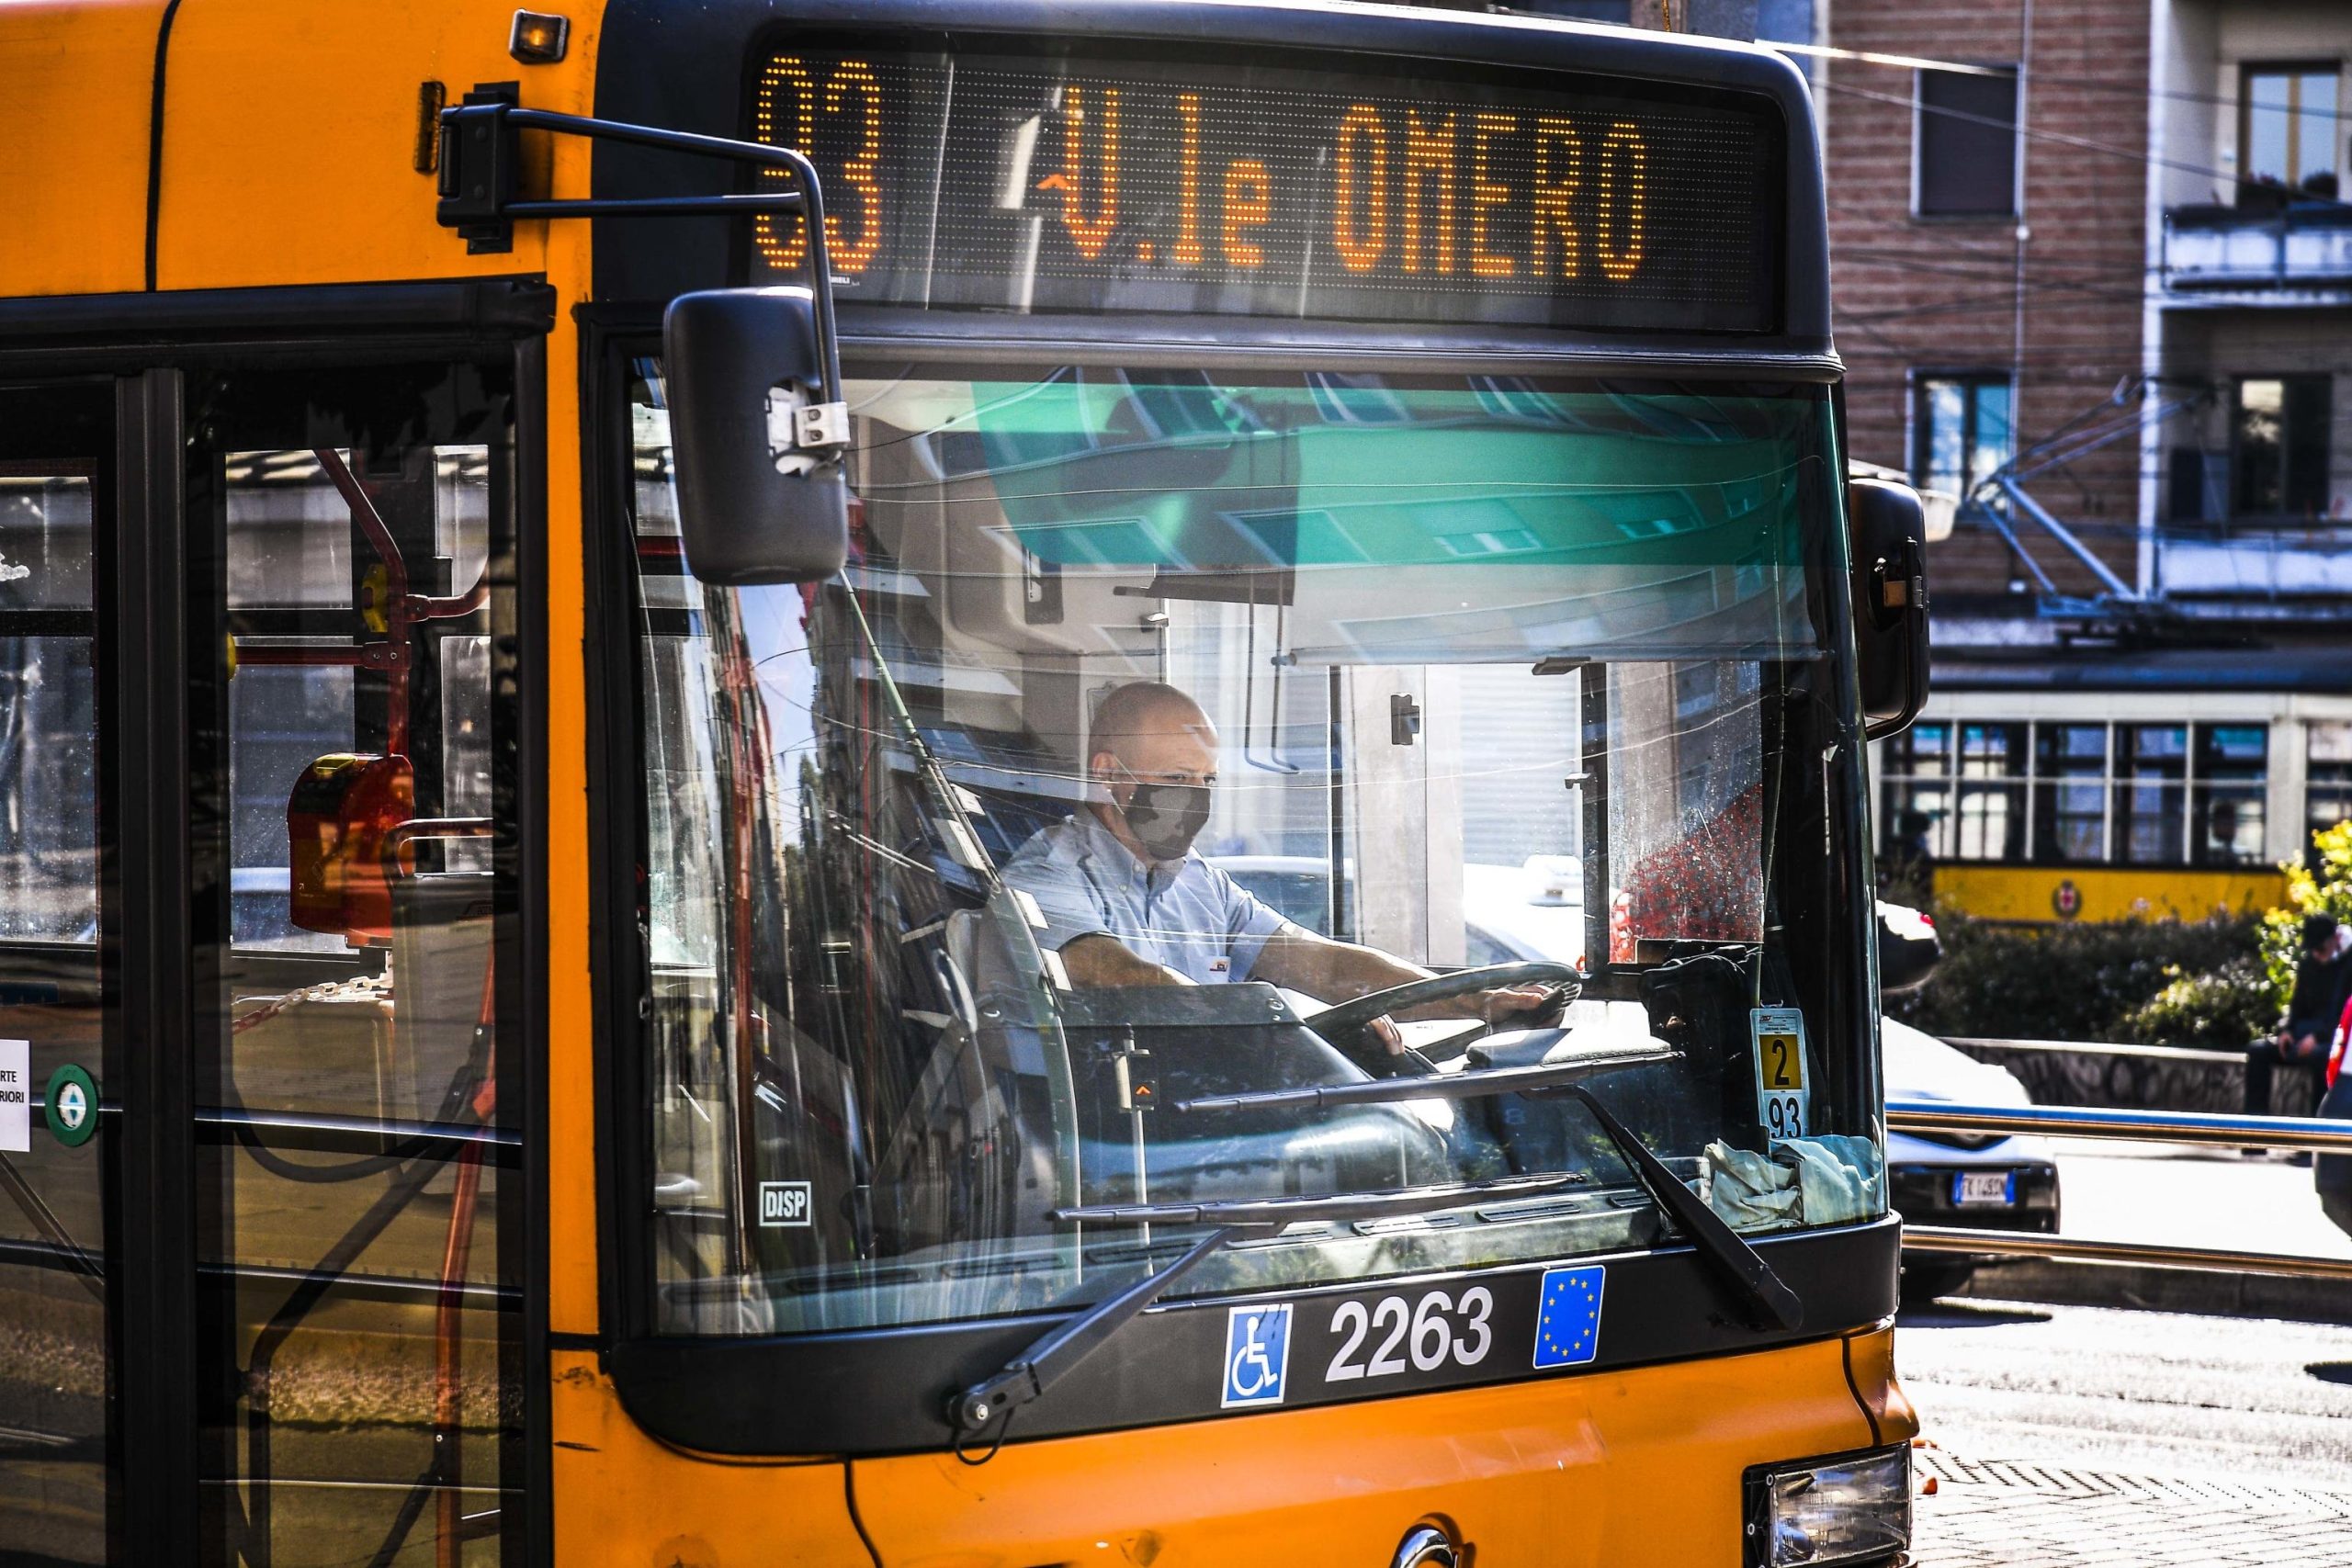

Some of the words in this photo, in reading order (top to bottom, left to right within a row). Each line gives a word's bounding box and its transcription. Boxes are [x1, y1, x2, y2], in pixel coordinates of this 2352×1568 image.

[1061, 85, 1271, 265] V.le
[1334, 104, 1646, 281] OMERO
[1772, 1039, 1790, 1086] 2
[1768, 1098, 1802, 1138] 93
[765, 1190, 806, 1217] DISP
[1325, 1286, 1494, 1383] 2263
